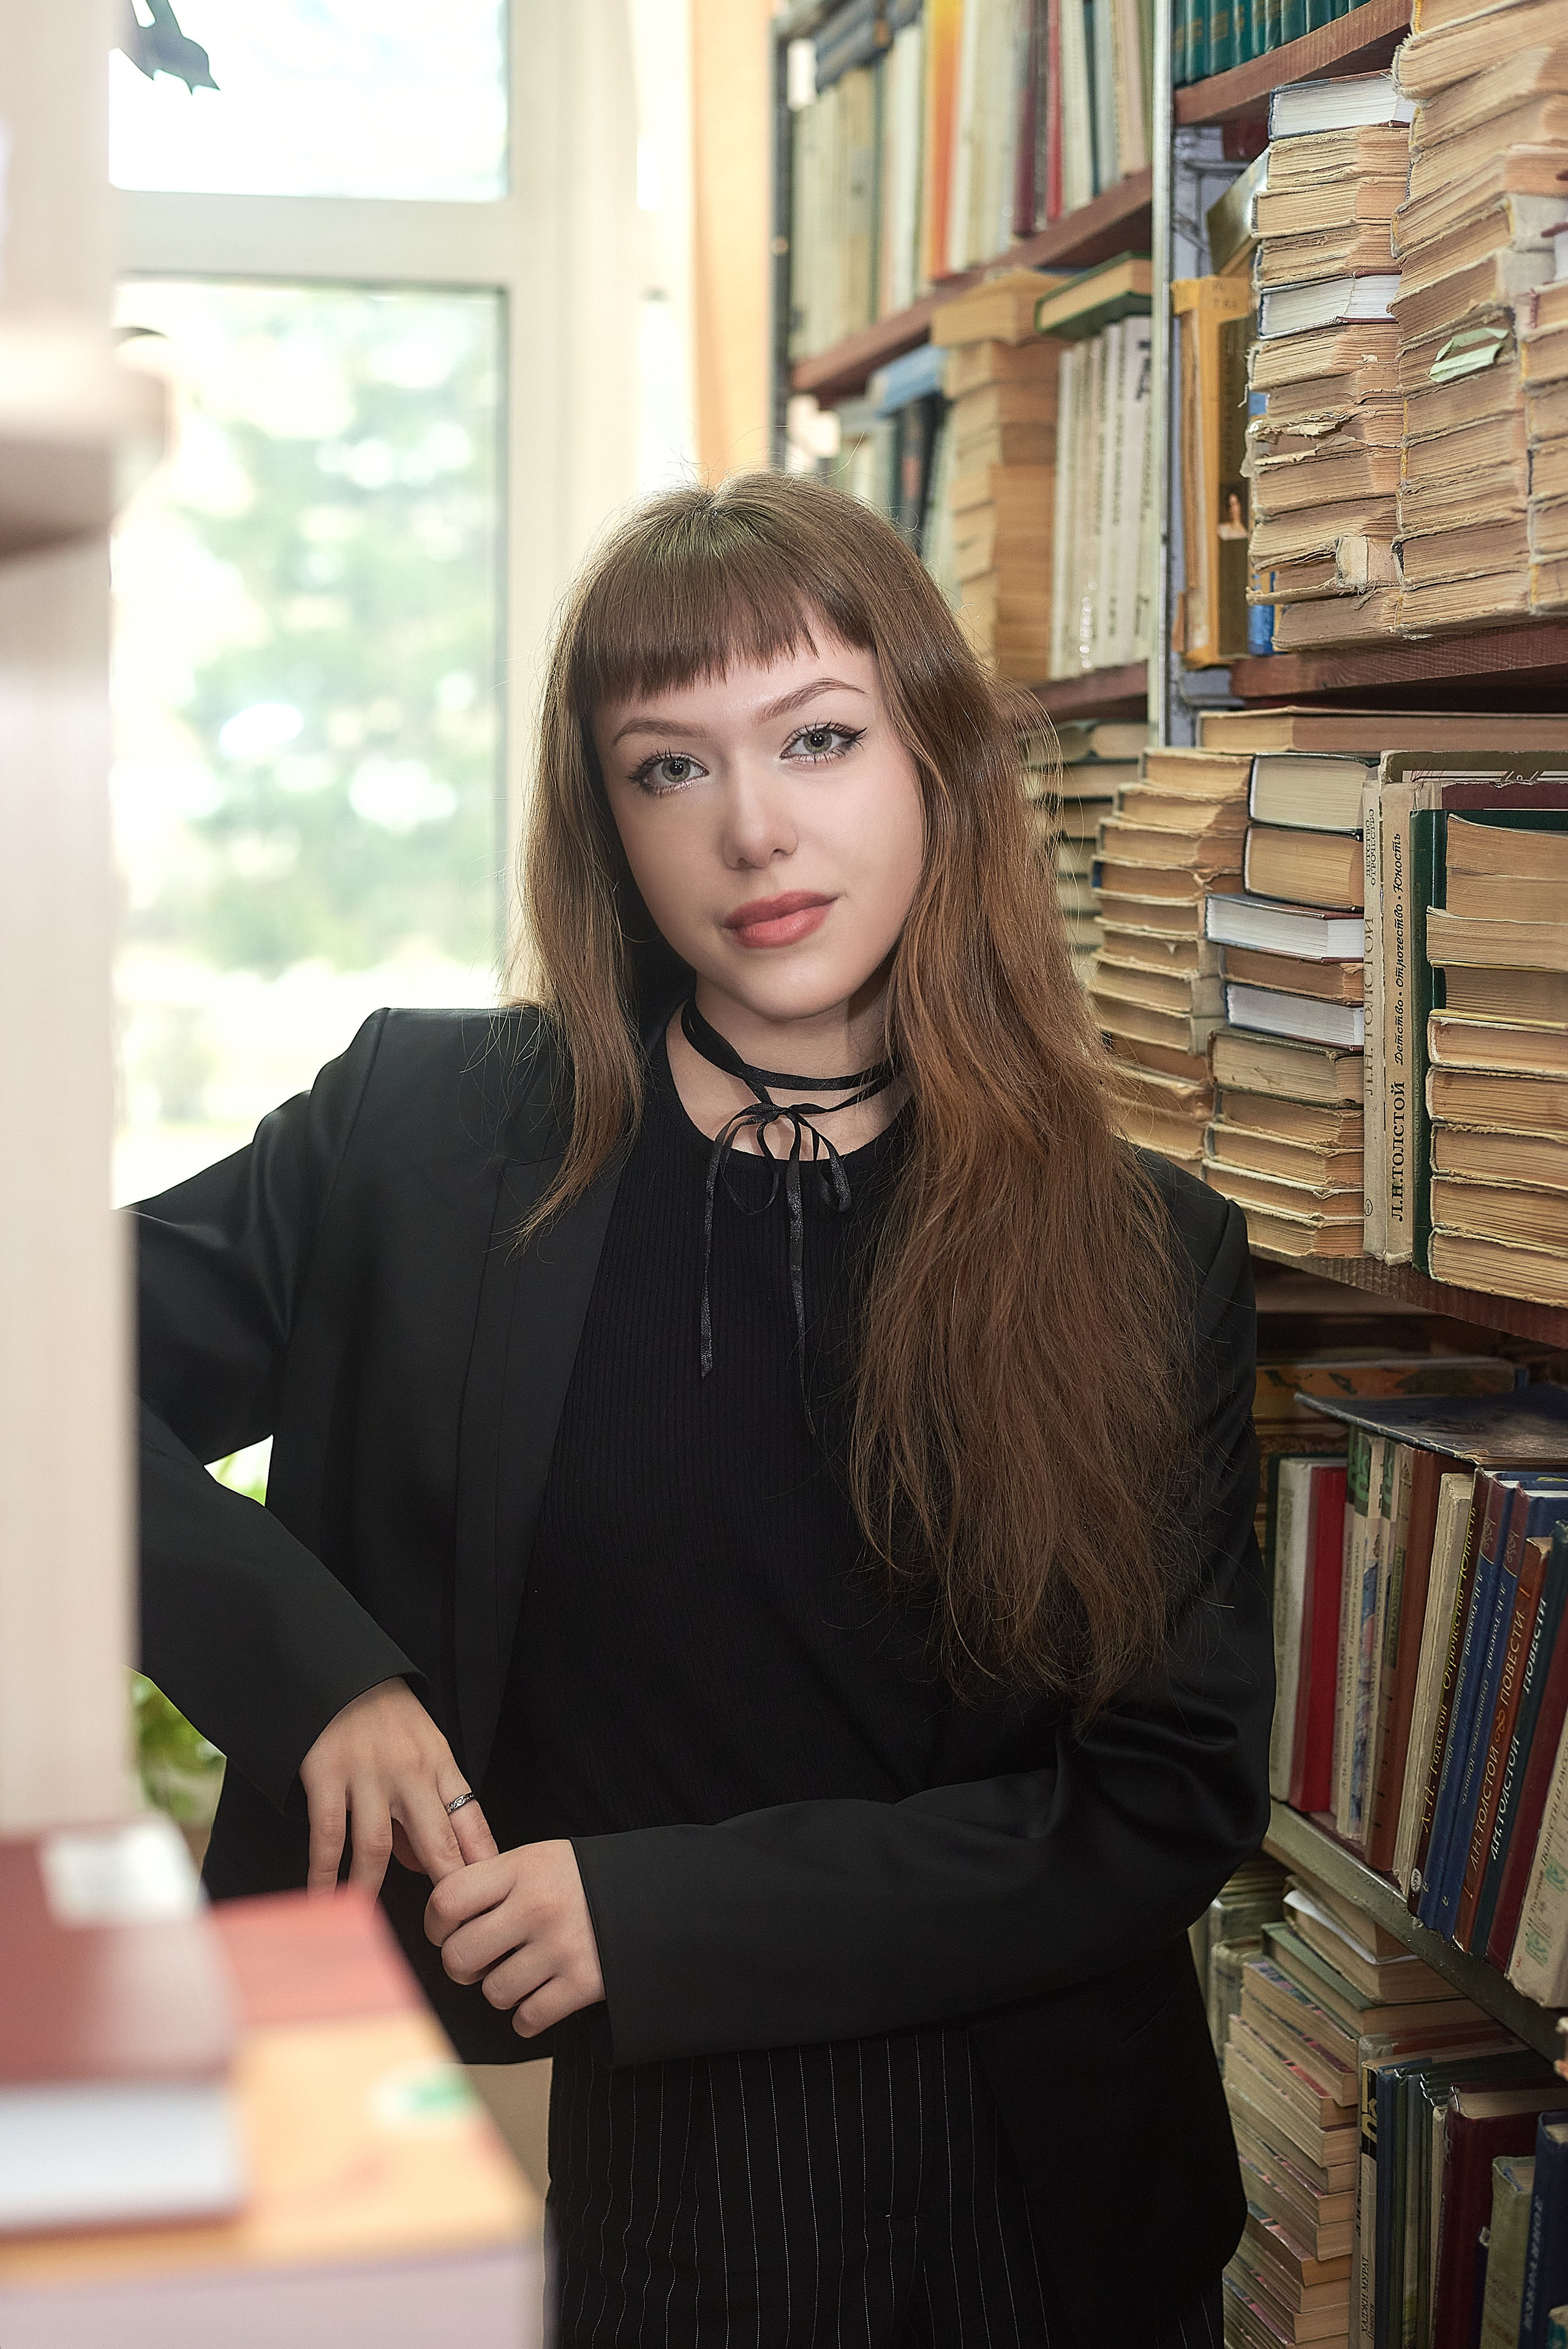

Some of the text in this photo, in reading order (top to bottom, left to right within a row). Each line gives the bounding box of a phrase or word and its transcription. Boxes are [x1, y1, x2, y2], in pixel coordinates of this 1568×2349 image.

[1392, 833, 1403, 893] Юность
[1393, 903, 1406, 988] Отрочество
[1393, 999, 1404, 1066] Детство
[1486, 1617, 1501, 1670] Толстой
[1475, 1745, 1499, 1833] ТОЛСТОЙ
[1500, 1610, 1525, 1706] ПОВЕСТИ
